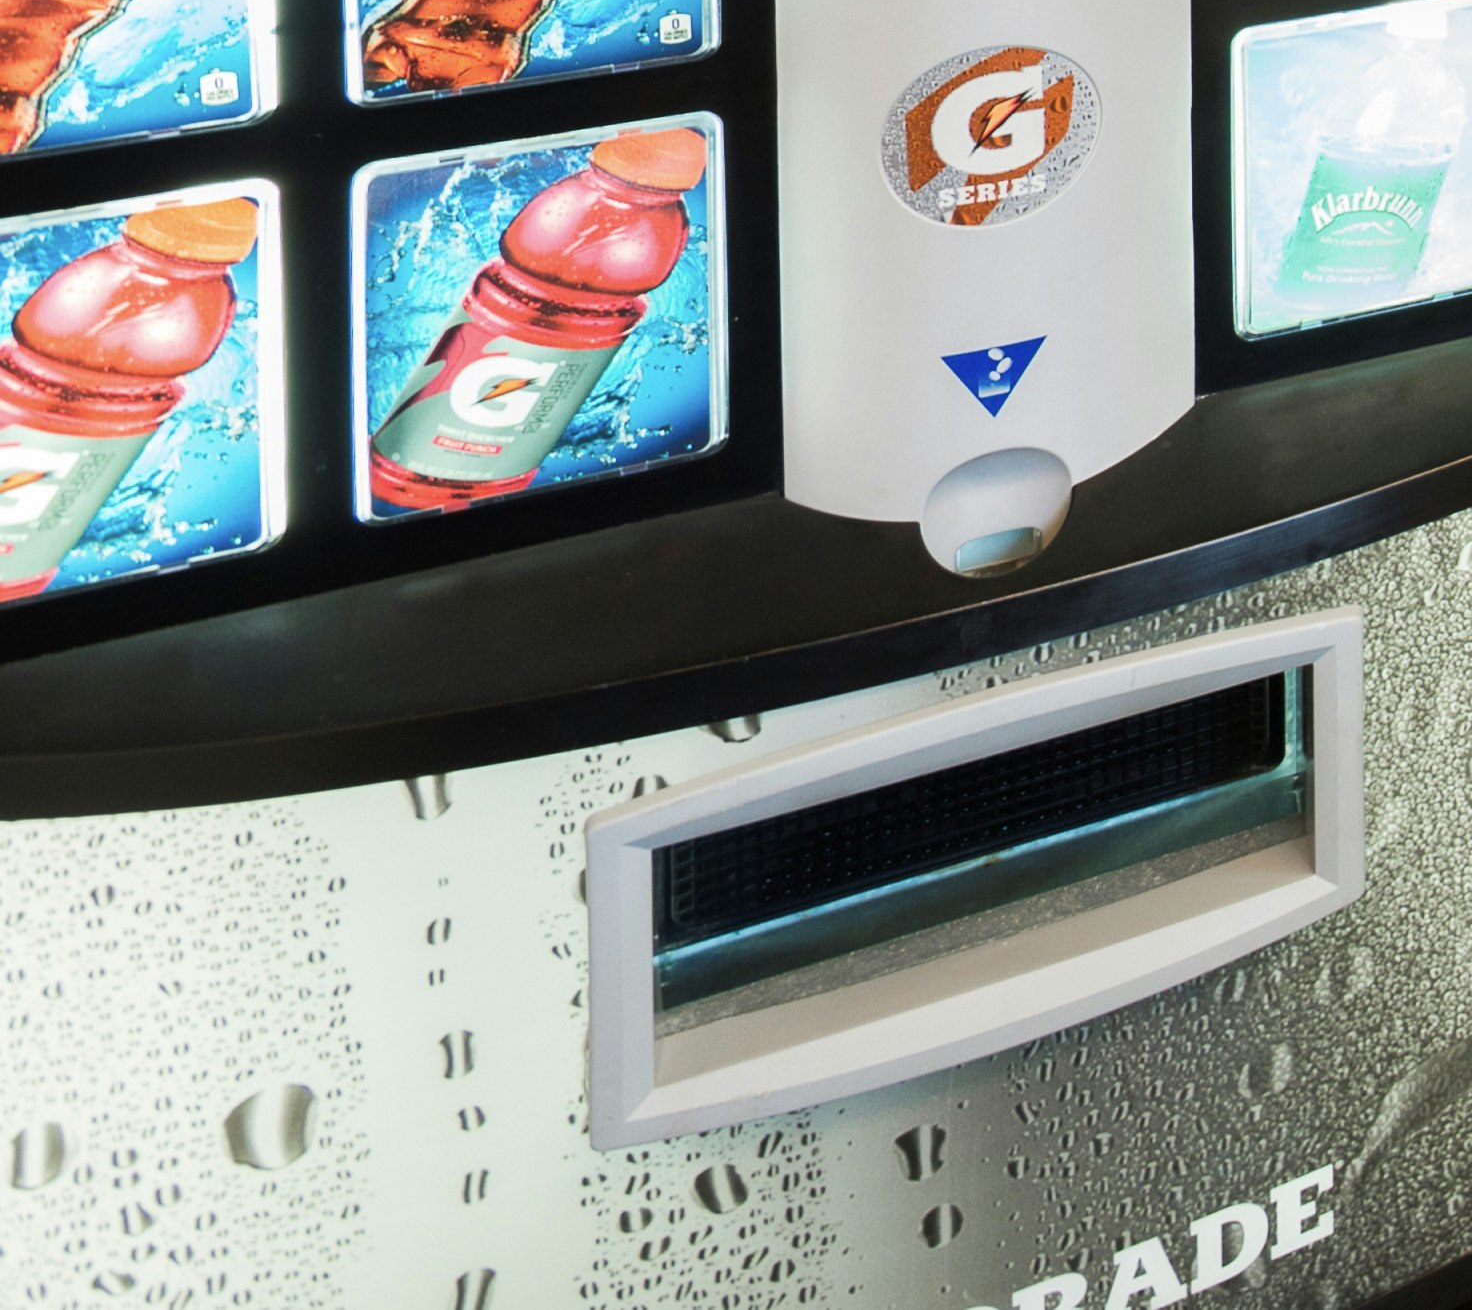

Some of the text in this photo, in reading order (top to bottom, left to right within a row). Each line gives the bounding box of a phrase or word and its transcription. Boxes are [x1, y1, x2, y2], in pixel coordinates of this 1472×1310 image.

[670, 18, 681, 30] 0
[214, 76, 225, 90] 0
[931, 64, 1047, 176] G
[938, 172, 1048, 211] SERIES
[1310, 185, 1425, 233] Klarbrunn
[449, 356, 559, 428] G
[437, 437, 498, 453] FRUIT PUNCH
[960, 1164, 1334, 1310] ADE
